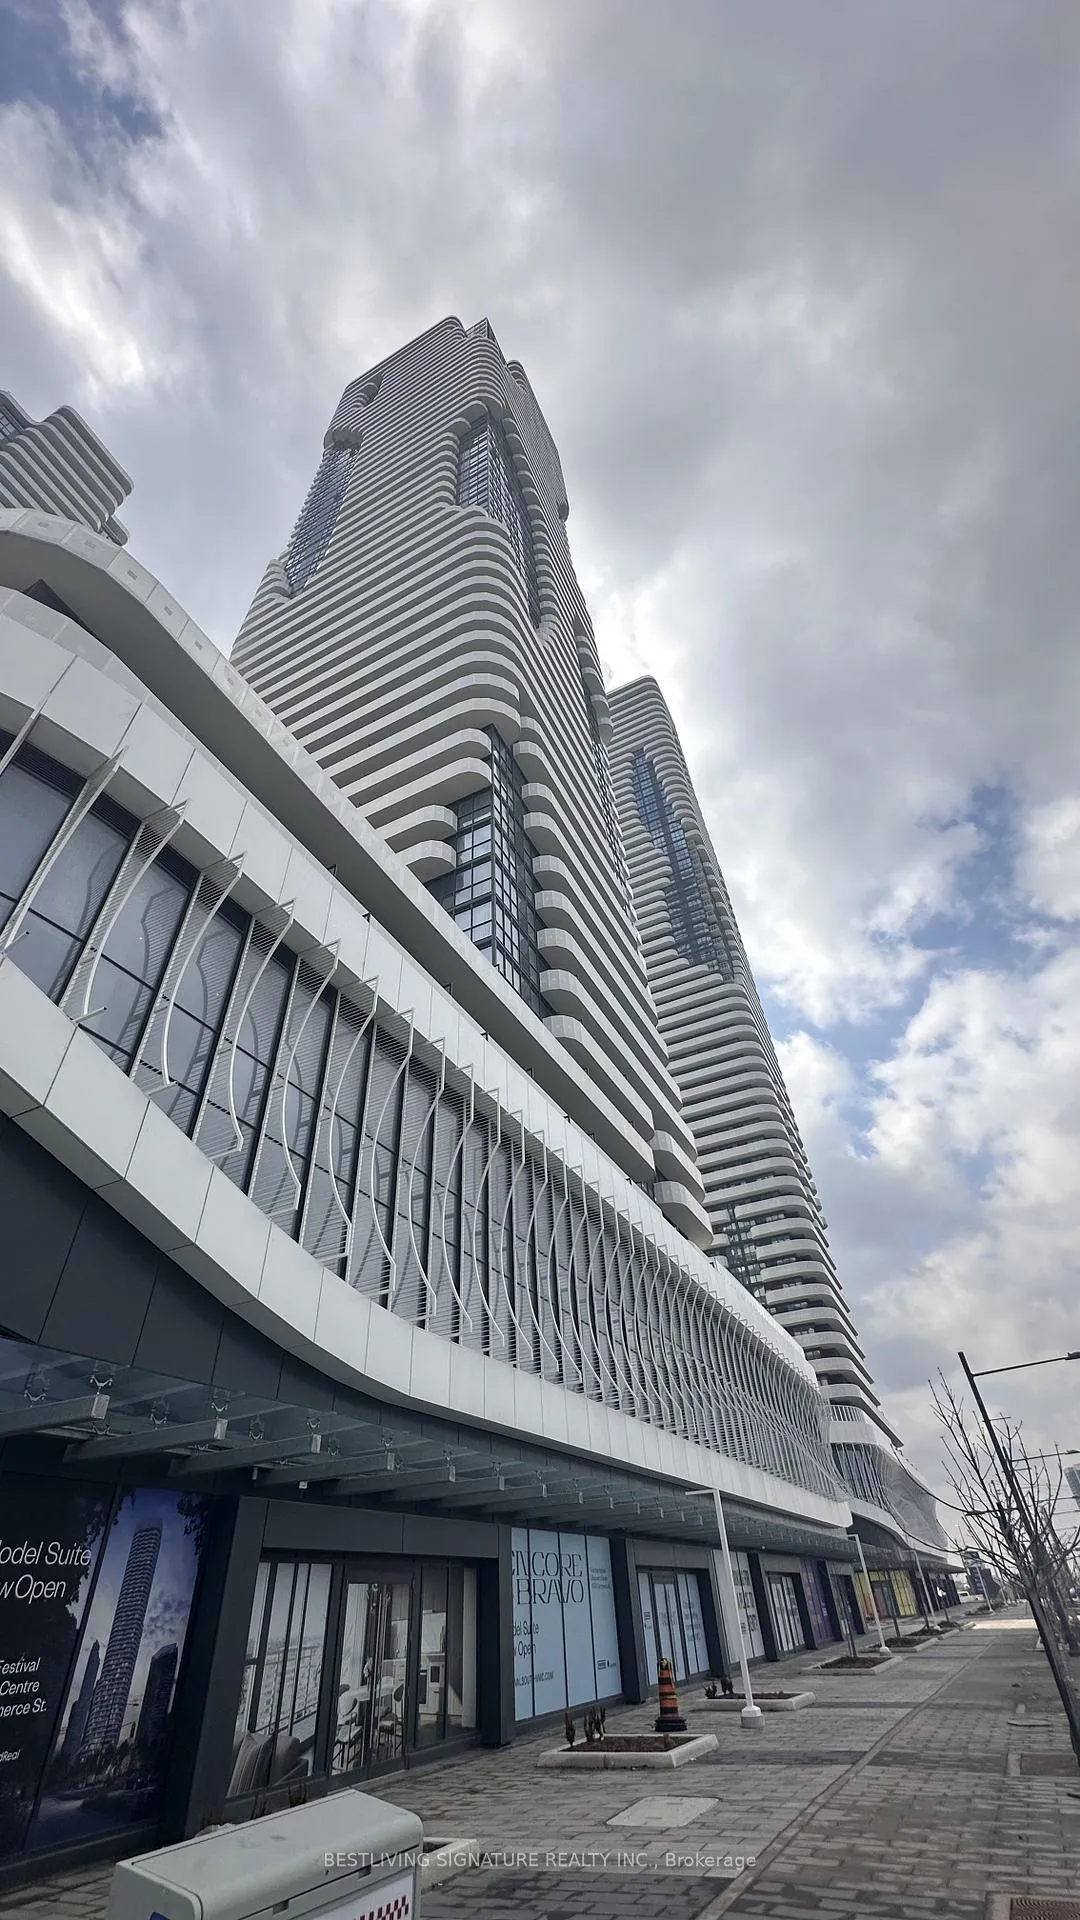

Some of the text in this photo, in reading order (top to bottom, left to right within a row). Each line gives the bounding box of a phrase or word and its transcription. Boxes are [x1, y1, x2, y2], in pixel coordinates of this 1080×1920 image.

[0, 1540, 92, 1566] odel Suite
[15, 1574, 66, 1604] Open
[516, 1578, 584, 1605] BRAVO
[0, 1680, 40, 1696] Centre
[32, 1697, 47, 1713] St.
